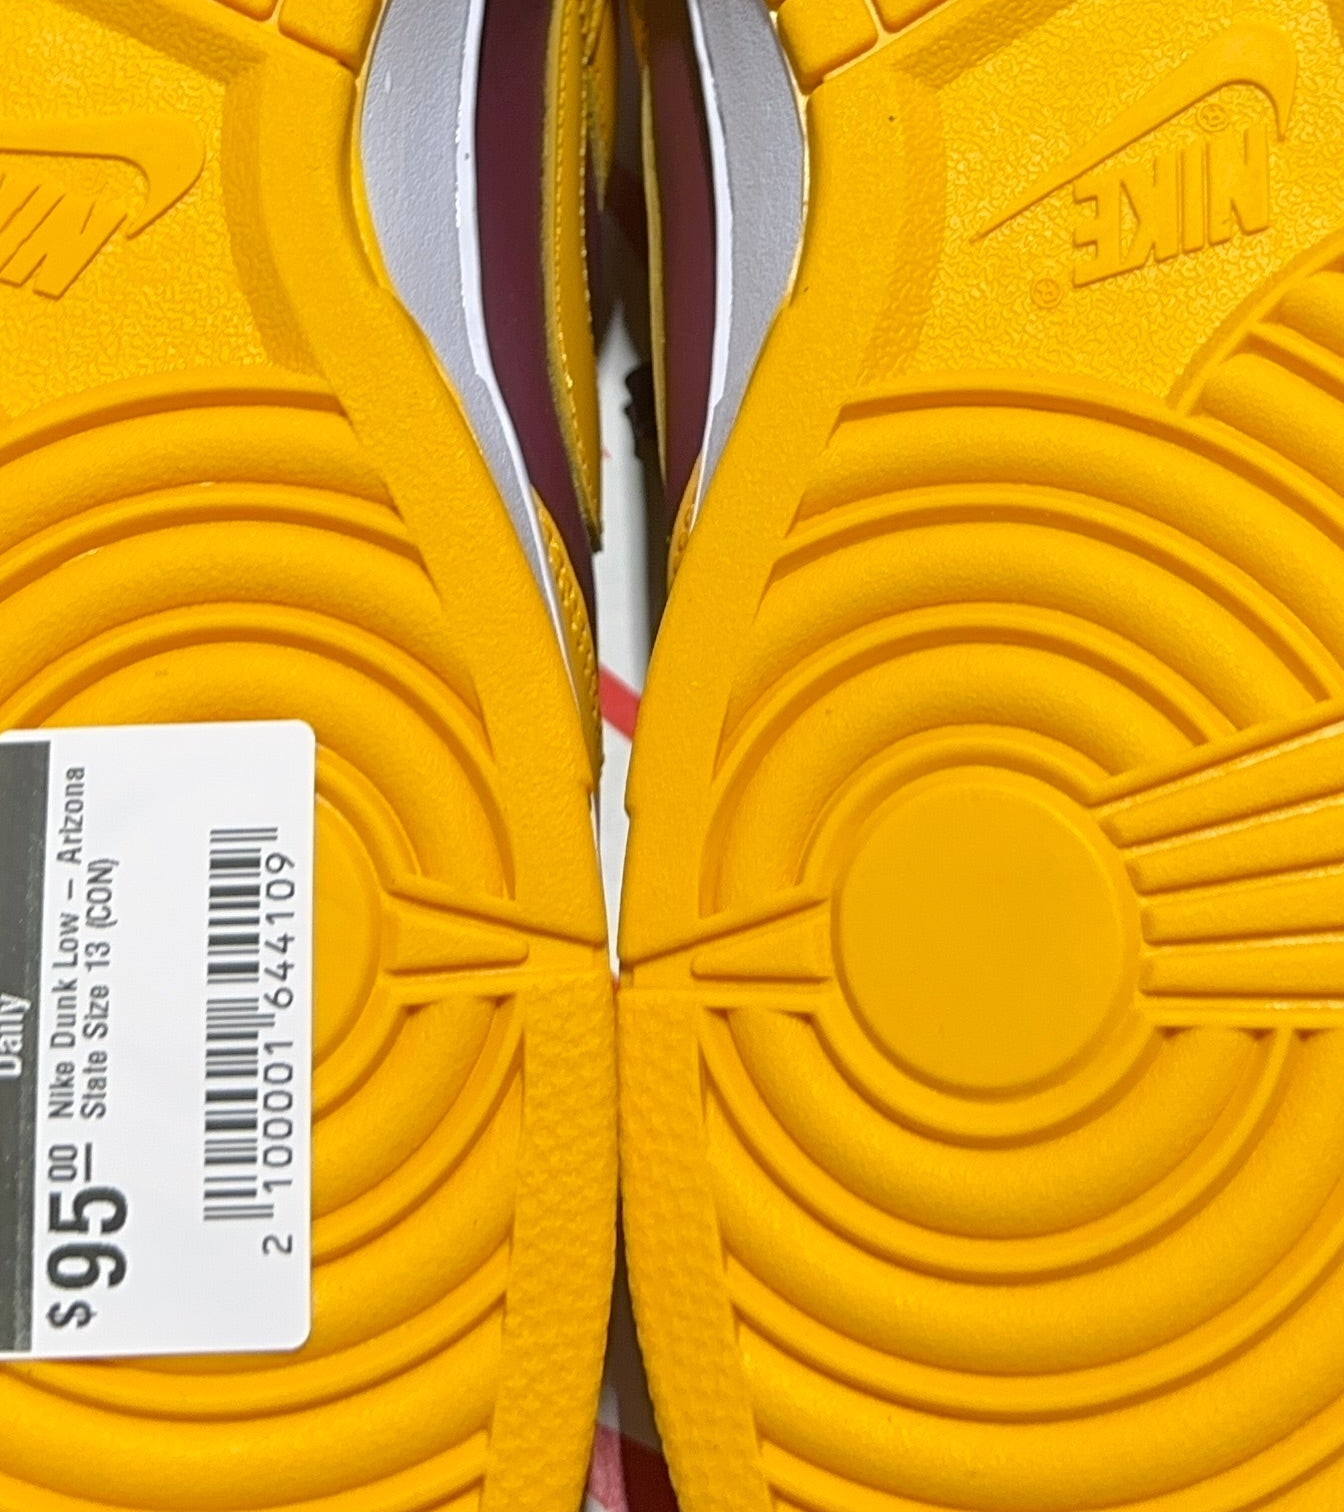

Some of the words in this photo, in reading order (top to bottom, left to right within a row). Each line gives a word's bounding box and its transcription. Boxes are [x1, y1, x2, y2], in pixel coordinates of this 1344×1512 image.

[1071, 117, 1271, 289] NIKE
[56, 766, 86, 865] Arizona
[86, 857, 120, 929] (CON)
[52, 912, 80, 969] Low
[84, 941, 111, 973] 13
[50, 978, 78, 1048] Dunk
[82, 985, 110, 1039] Size
[48, 1063, 76, 1119] Nike
[80, 1051, 108, 1120] State
